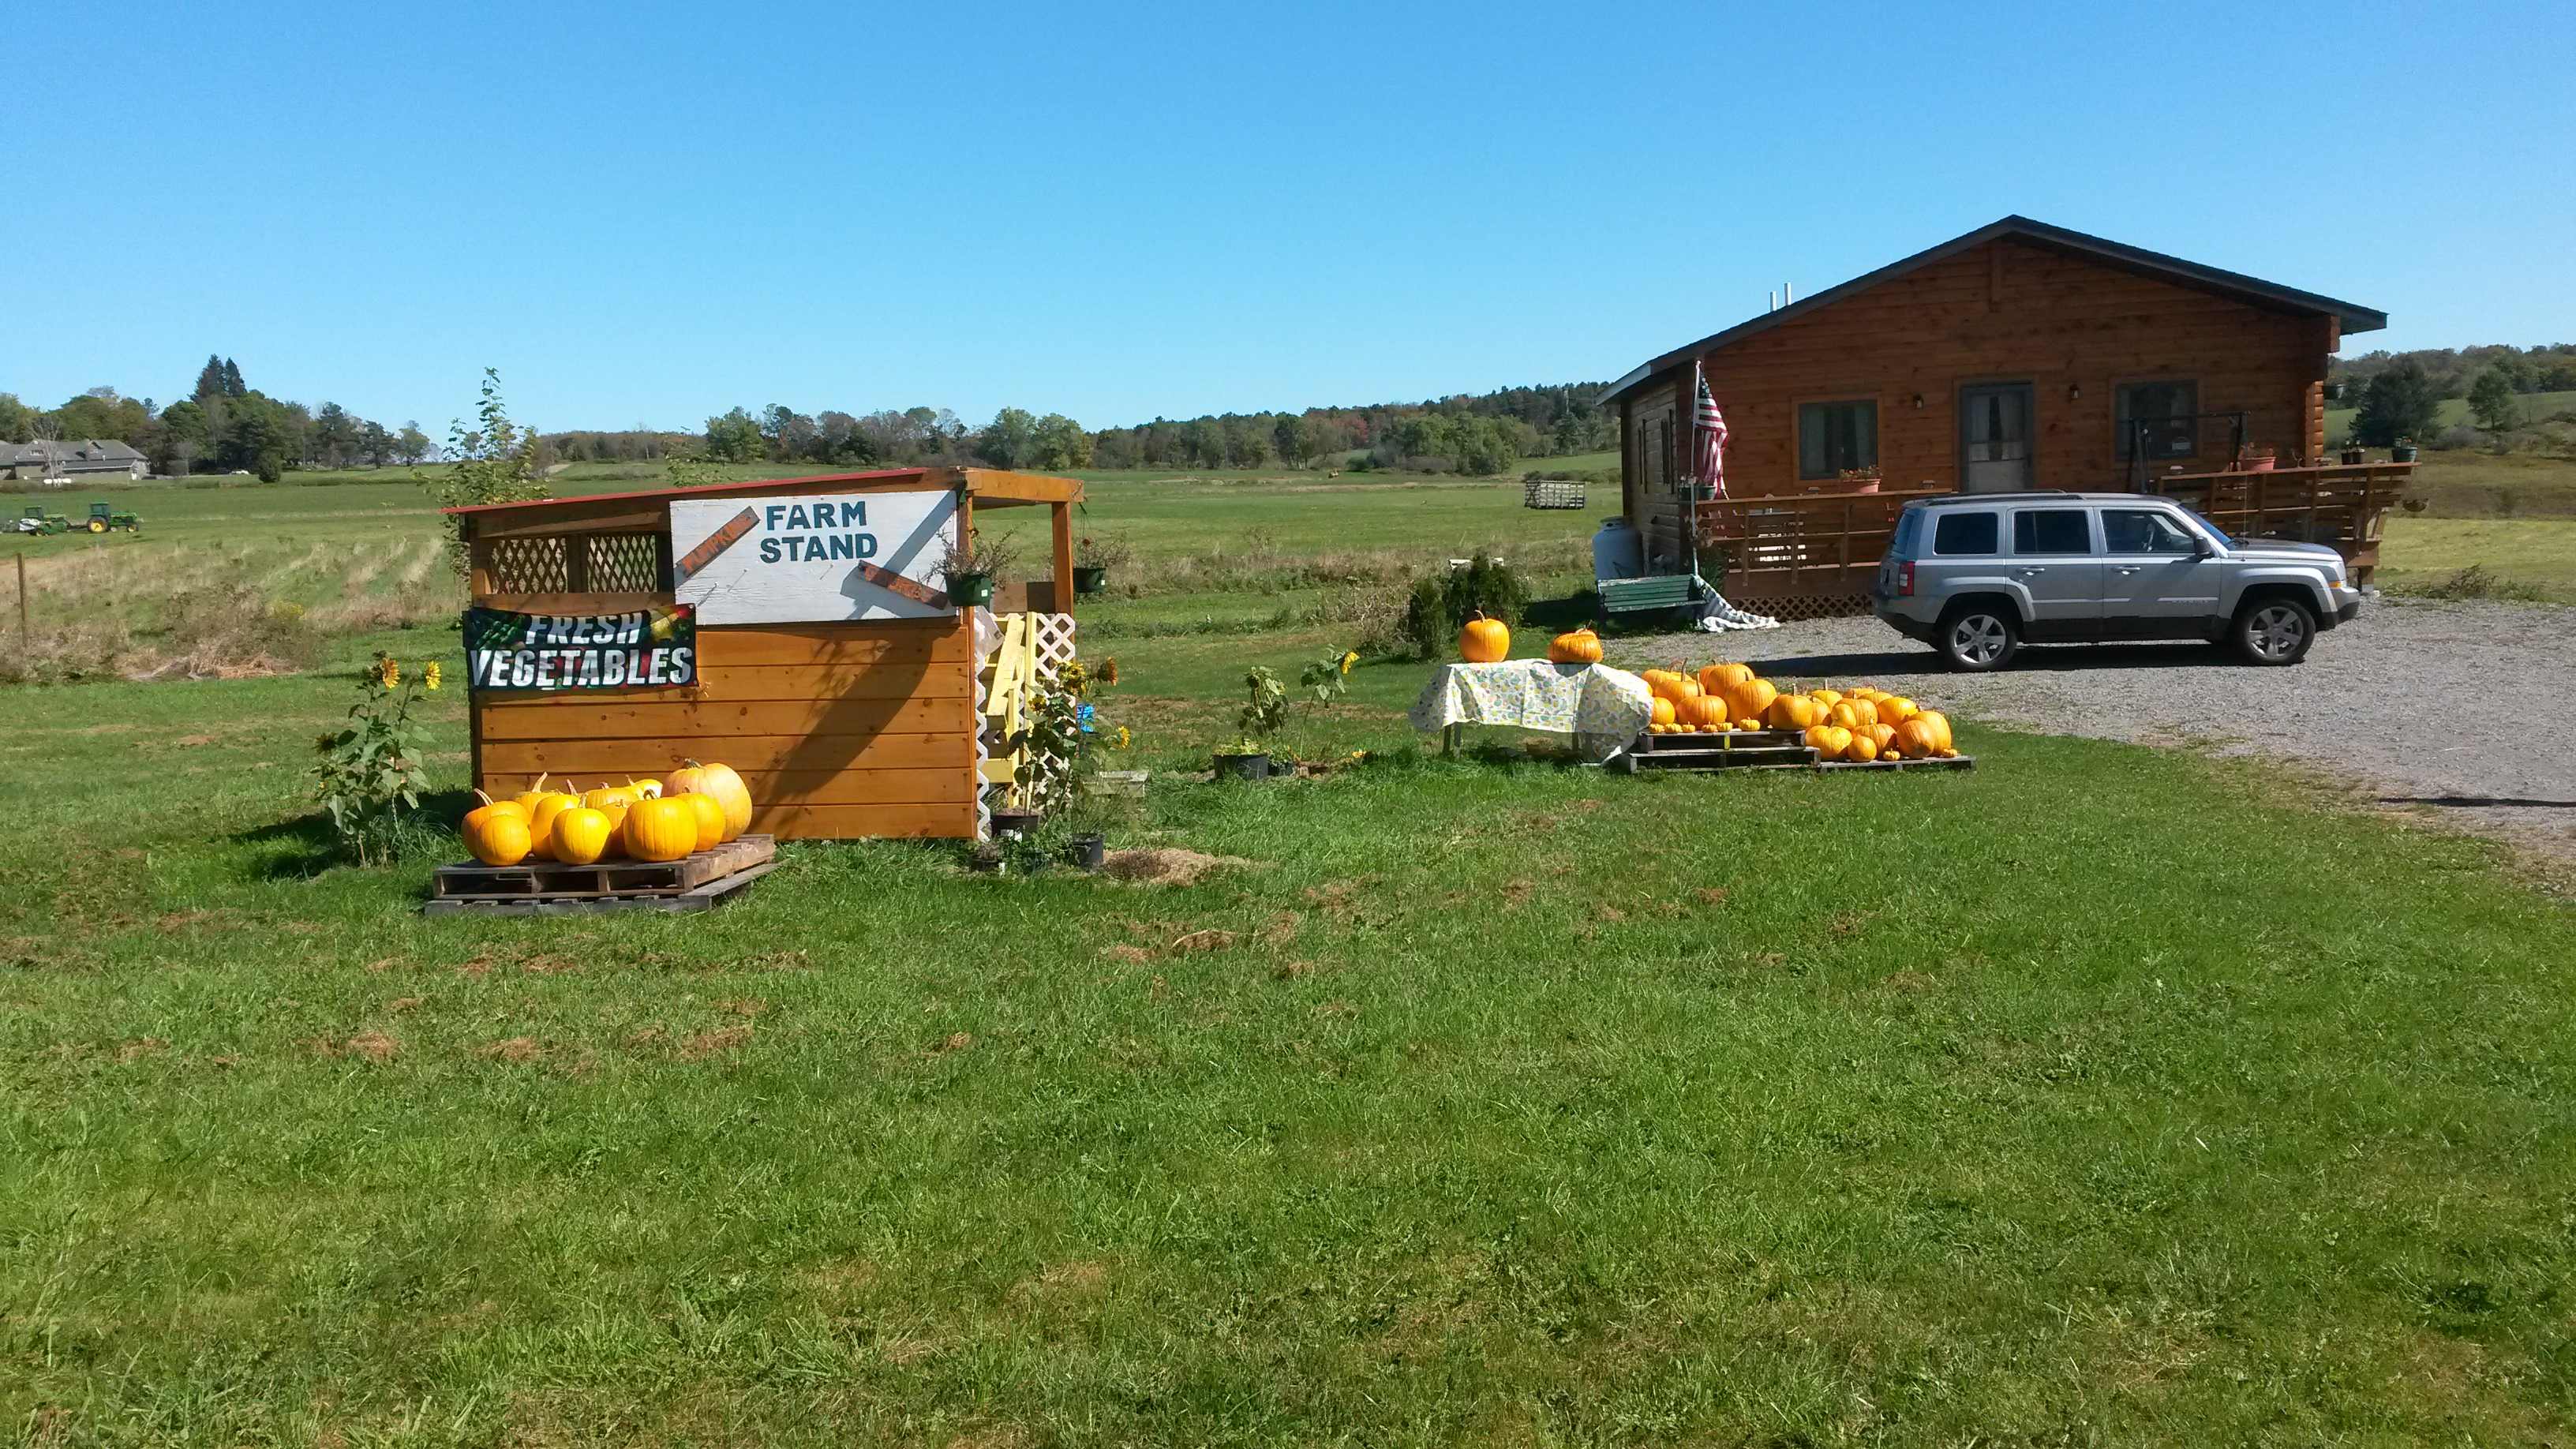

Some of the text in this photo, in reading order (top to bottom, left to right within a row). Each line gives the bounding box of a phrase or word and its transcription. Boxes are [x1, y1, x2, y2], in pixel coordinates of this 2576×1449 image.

[766, 500, 867, 531] FARM
[759, 533, 878, 564] STAND
[525, 612, 643, 645] FRESH
[470, 647, 693, 687] VEGETABLES
